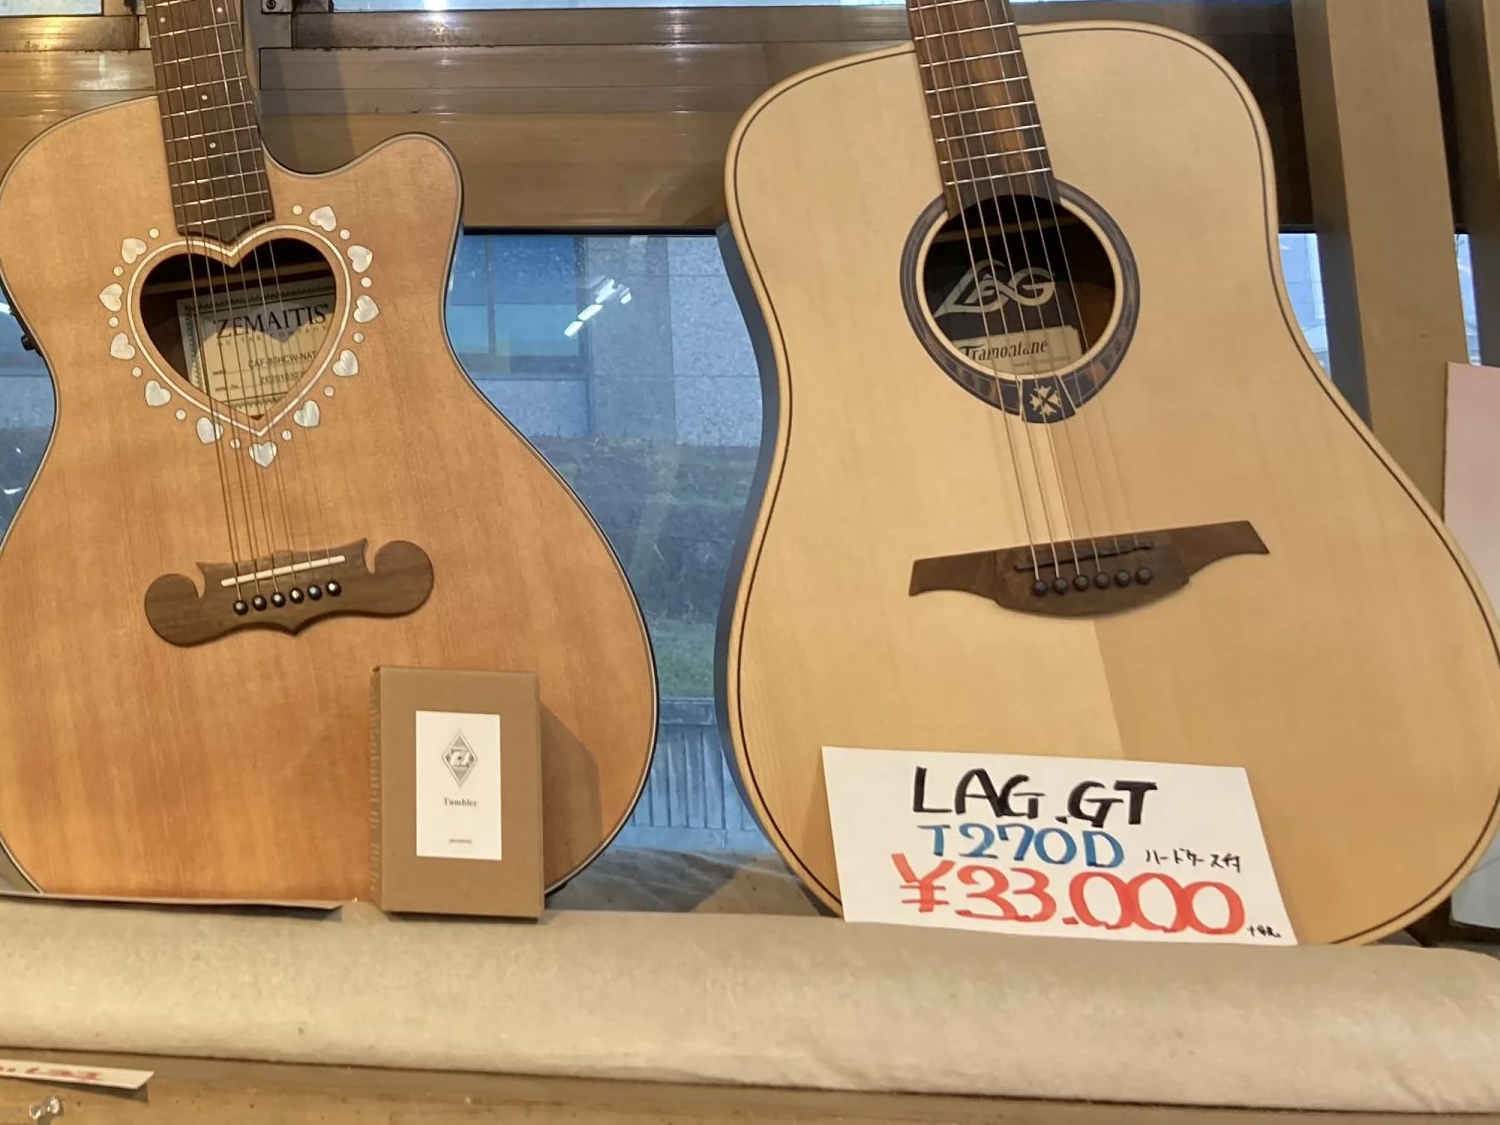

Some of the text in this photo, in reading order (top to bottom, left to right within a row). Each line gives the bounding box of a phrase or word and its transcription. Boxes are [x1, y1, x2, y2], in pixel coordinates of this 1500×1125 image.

[213, 304, 328, 339] ZEMAITIS
[443, 797, 479, 807] Tumbler
[911, 766, 1158, 827] LAG.GT
[917, 822, 1125, 868] T270D
